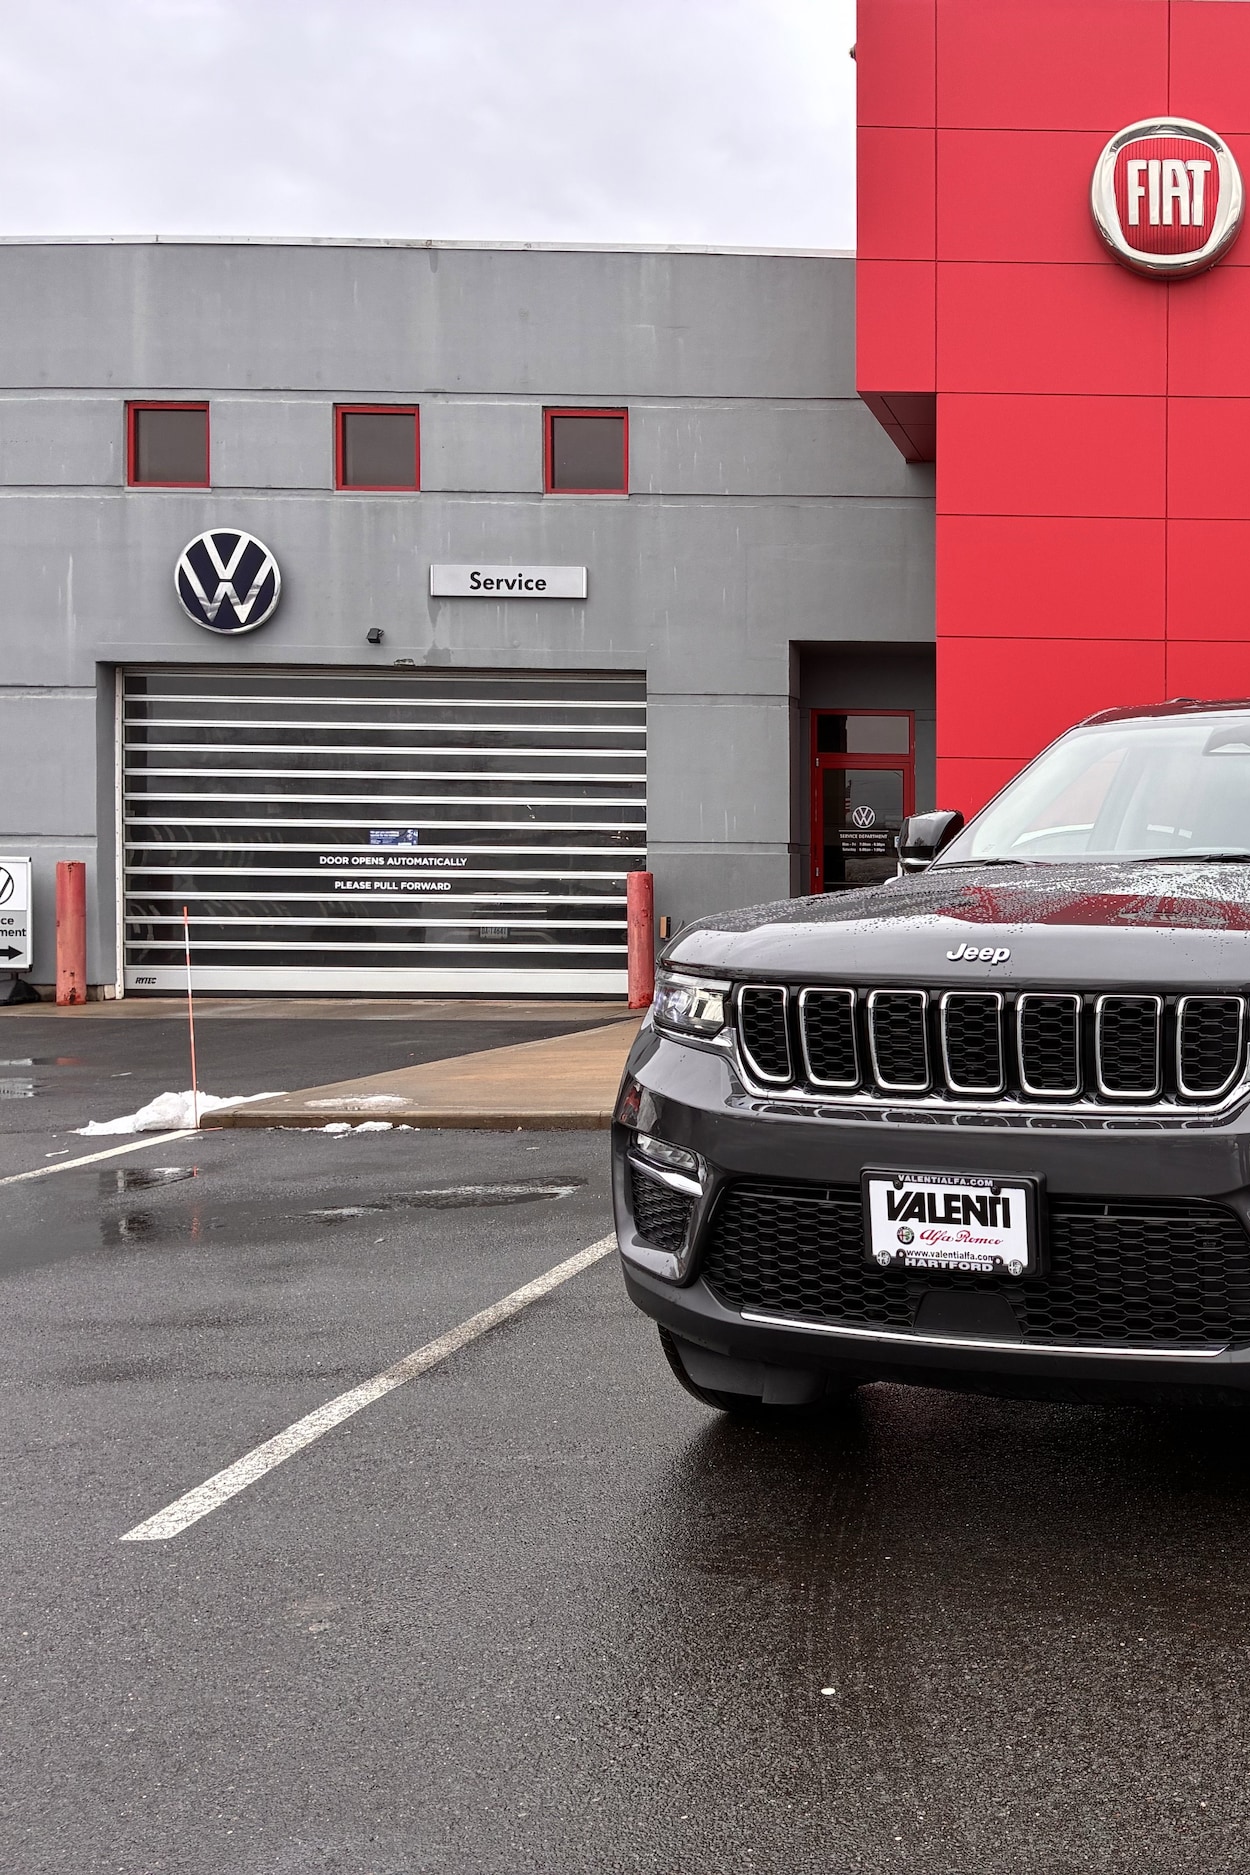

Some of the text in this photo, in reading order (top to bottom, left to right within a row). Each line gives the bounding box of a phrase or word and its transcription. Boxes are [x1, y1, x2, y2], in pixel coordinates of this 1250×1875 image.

[1127, 159, 1212, 227] FIAT
[469, 571, 547, 591] Service
[319, 856, 468, 867] DOOR OPENS AUTOMATICALLY
[334, 880, 452, 891] PLEASE PULL FORWARD
[946, 943, 1011, 966] Jeep
[135, 976, 157, 984] RYTEC
[898, 1175, 993, 1186] VALENTIALFA.COM
[886, 1190, 1011, 1229] VALENTI
[919, 1229, 955, 1246] Alfa
[955, 1230, 1004, 1245] Romeo
[905, 1258, 993, 1271] HARTFORD
